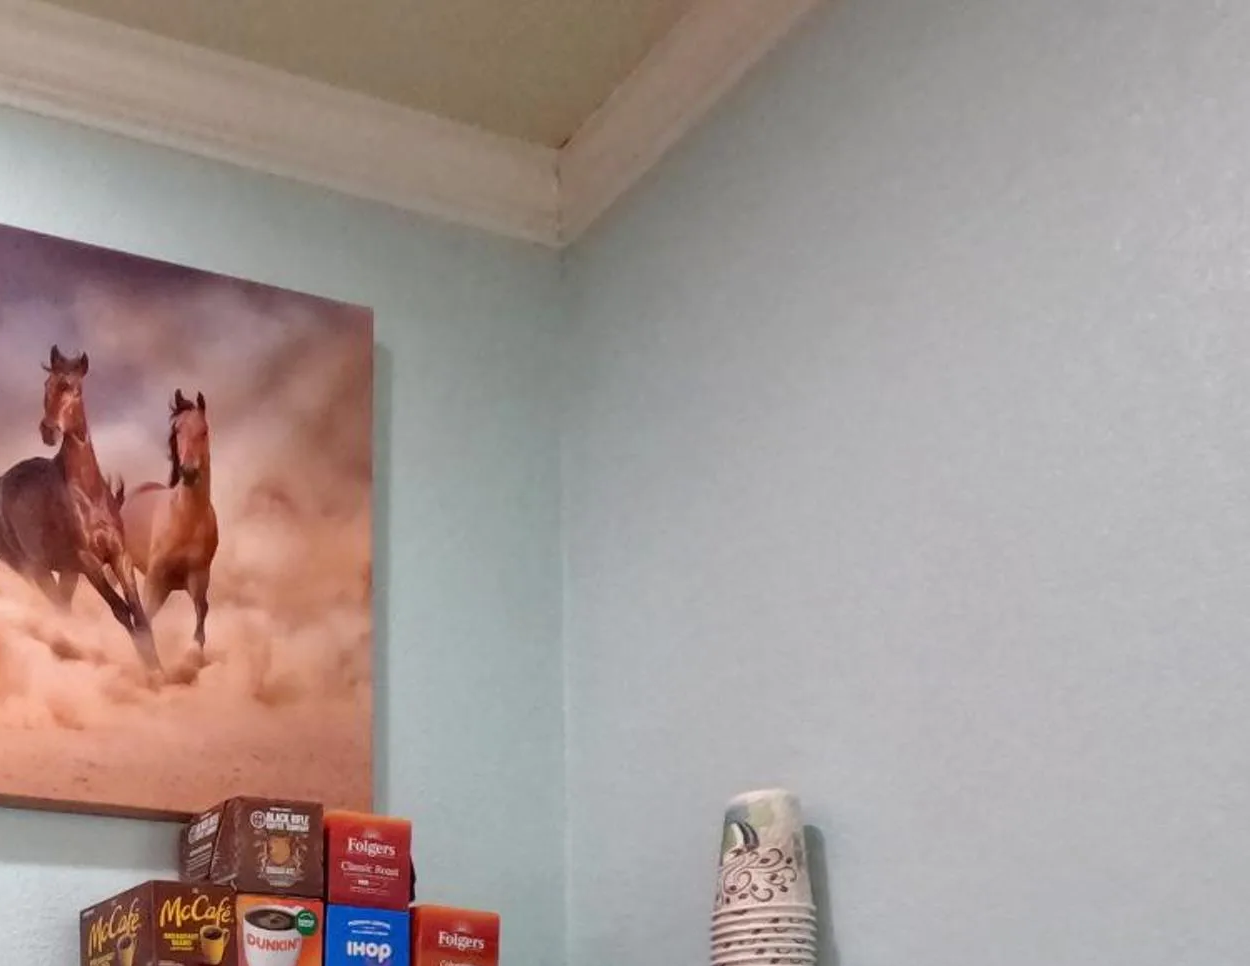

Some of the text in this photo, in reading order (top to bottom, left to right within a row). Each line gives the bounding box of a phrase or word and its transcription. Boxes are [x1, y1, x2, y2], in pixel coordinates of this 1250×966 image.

[347, 836, 396, 857] Folgers
[159, 894, 232, 928] McCafé
[438, 930, 485, 951] Folgers
[346, 941, 391, 963] IHOP
